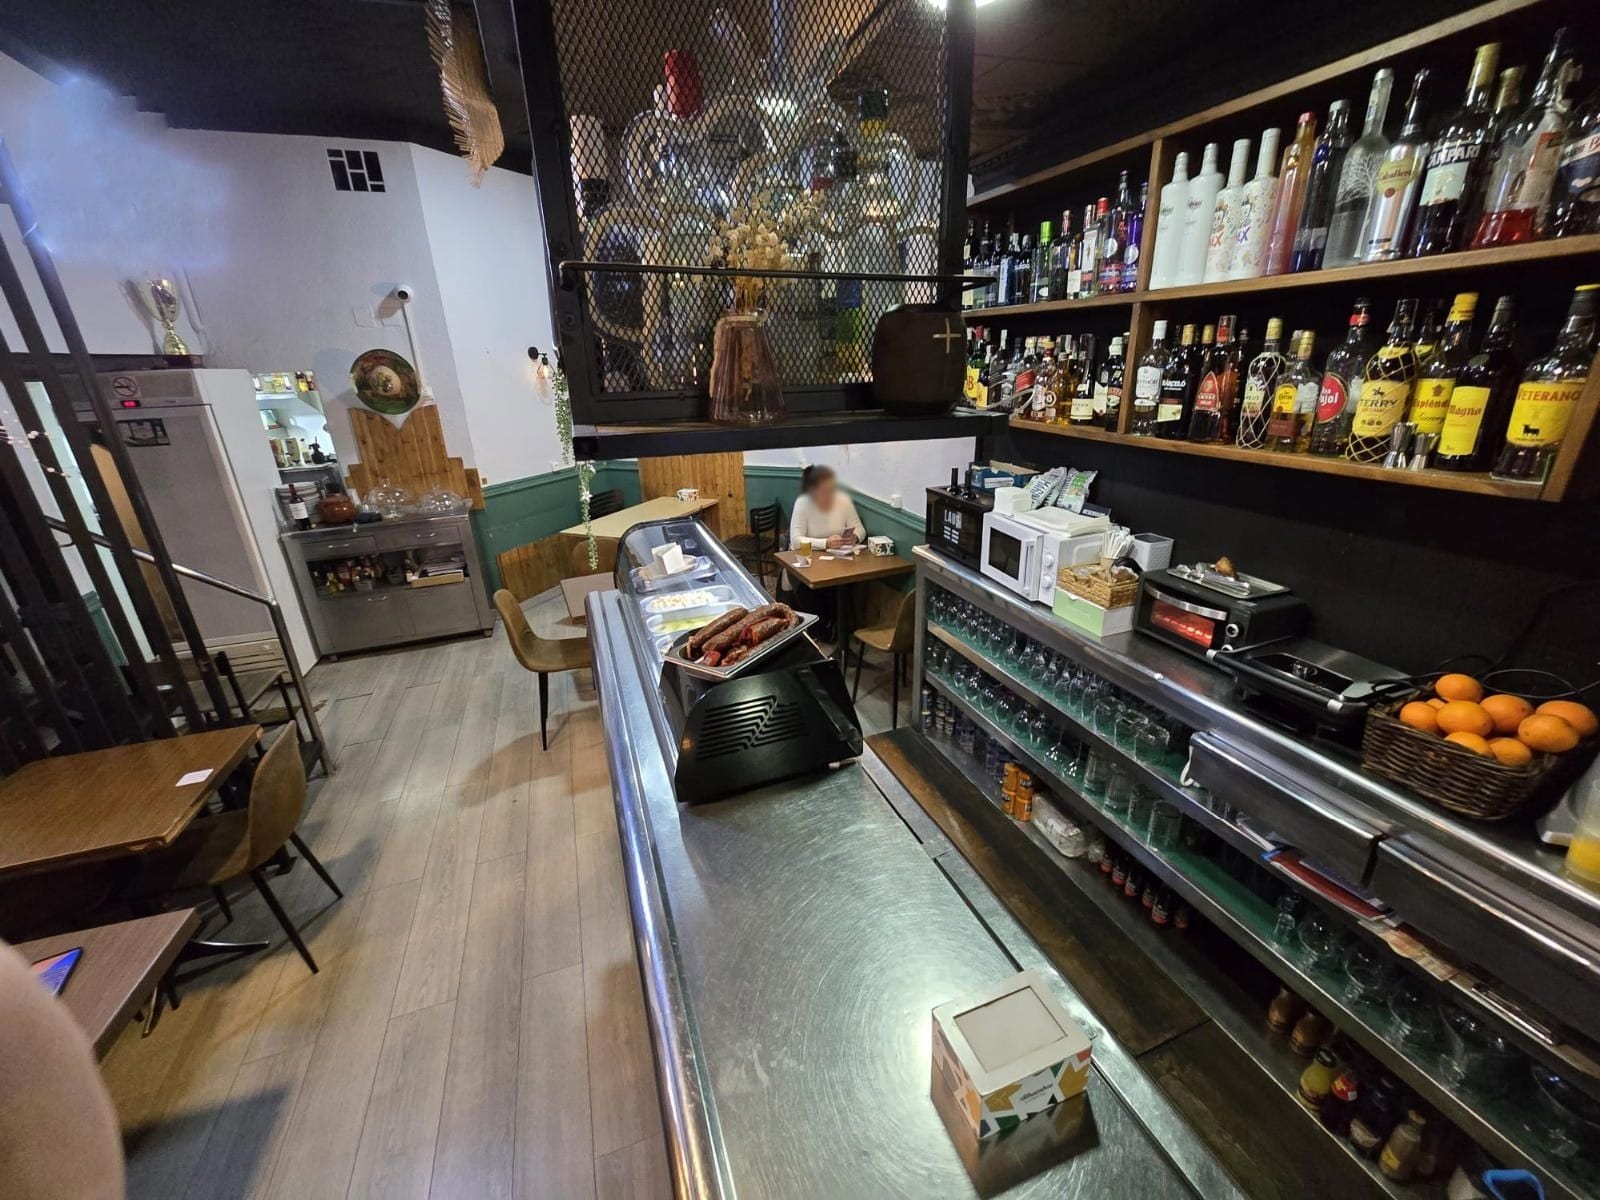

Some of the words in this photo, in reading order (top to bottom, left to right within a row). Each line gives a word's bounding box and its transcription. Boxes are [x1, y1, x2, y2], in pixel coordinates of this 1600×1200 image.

[1427, 143, 1481, 169] AMPARI
[1320, 391, 1339, 406] ujol
[1518, 390, 1583, 402] VETERANO
[1360, 399, 1400, 408] TERRY
[1449, 404, 1482, 417] Magno
